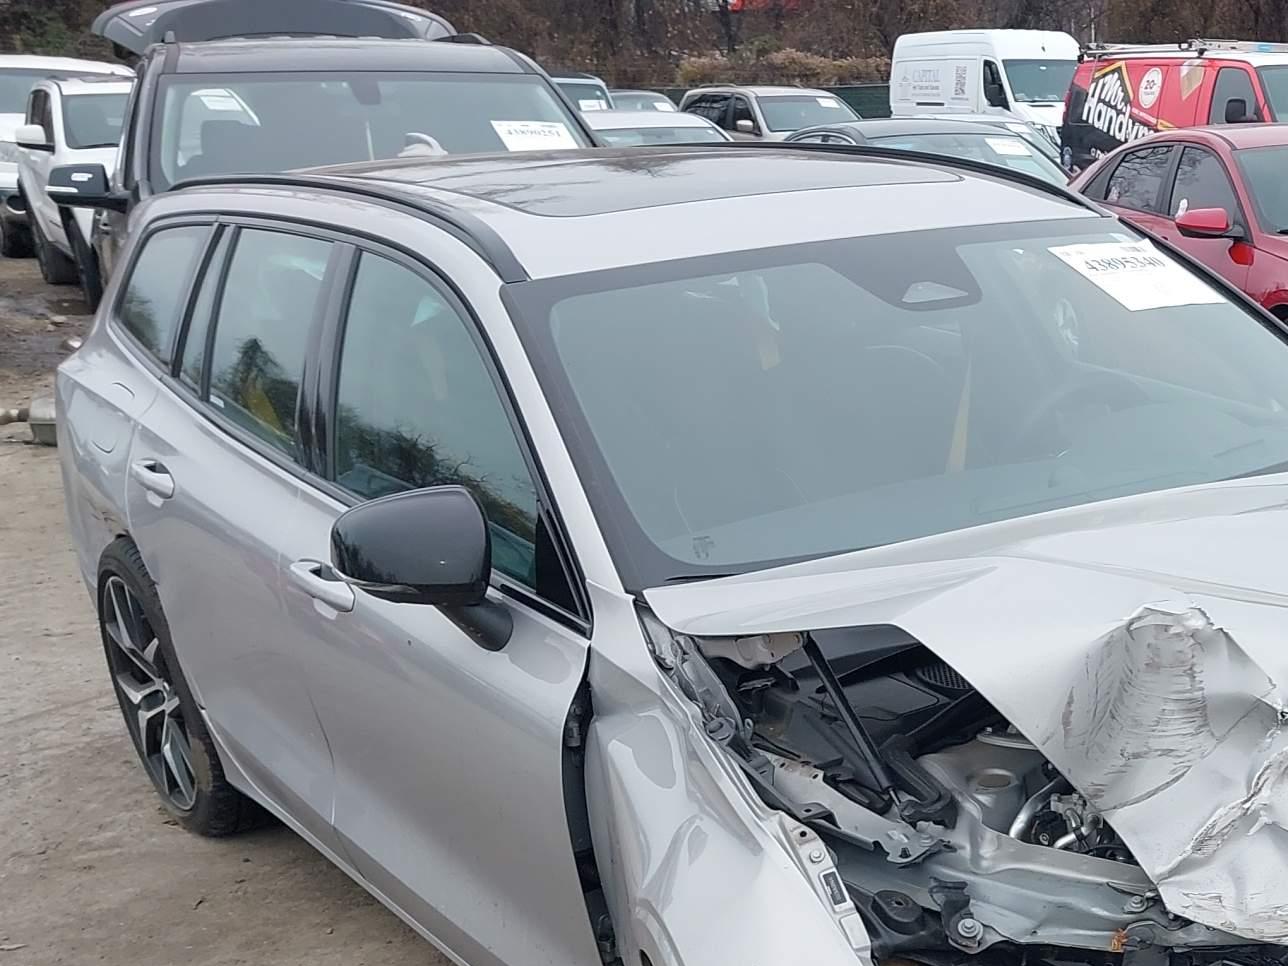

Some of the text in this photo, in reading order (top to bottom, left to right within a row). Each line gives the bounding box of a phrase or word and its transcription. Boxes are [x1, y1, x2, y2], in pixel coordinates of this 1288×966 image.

[1082, 79, 1156, 143] Handym
[1101, 72, 1127, 112] Mr.
[1084, 256, 1166, 272] 43895340
